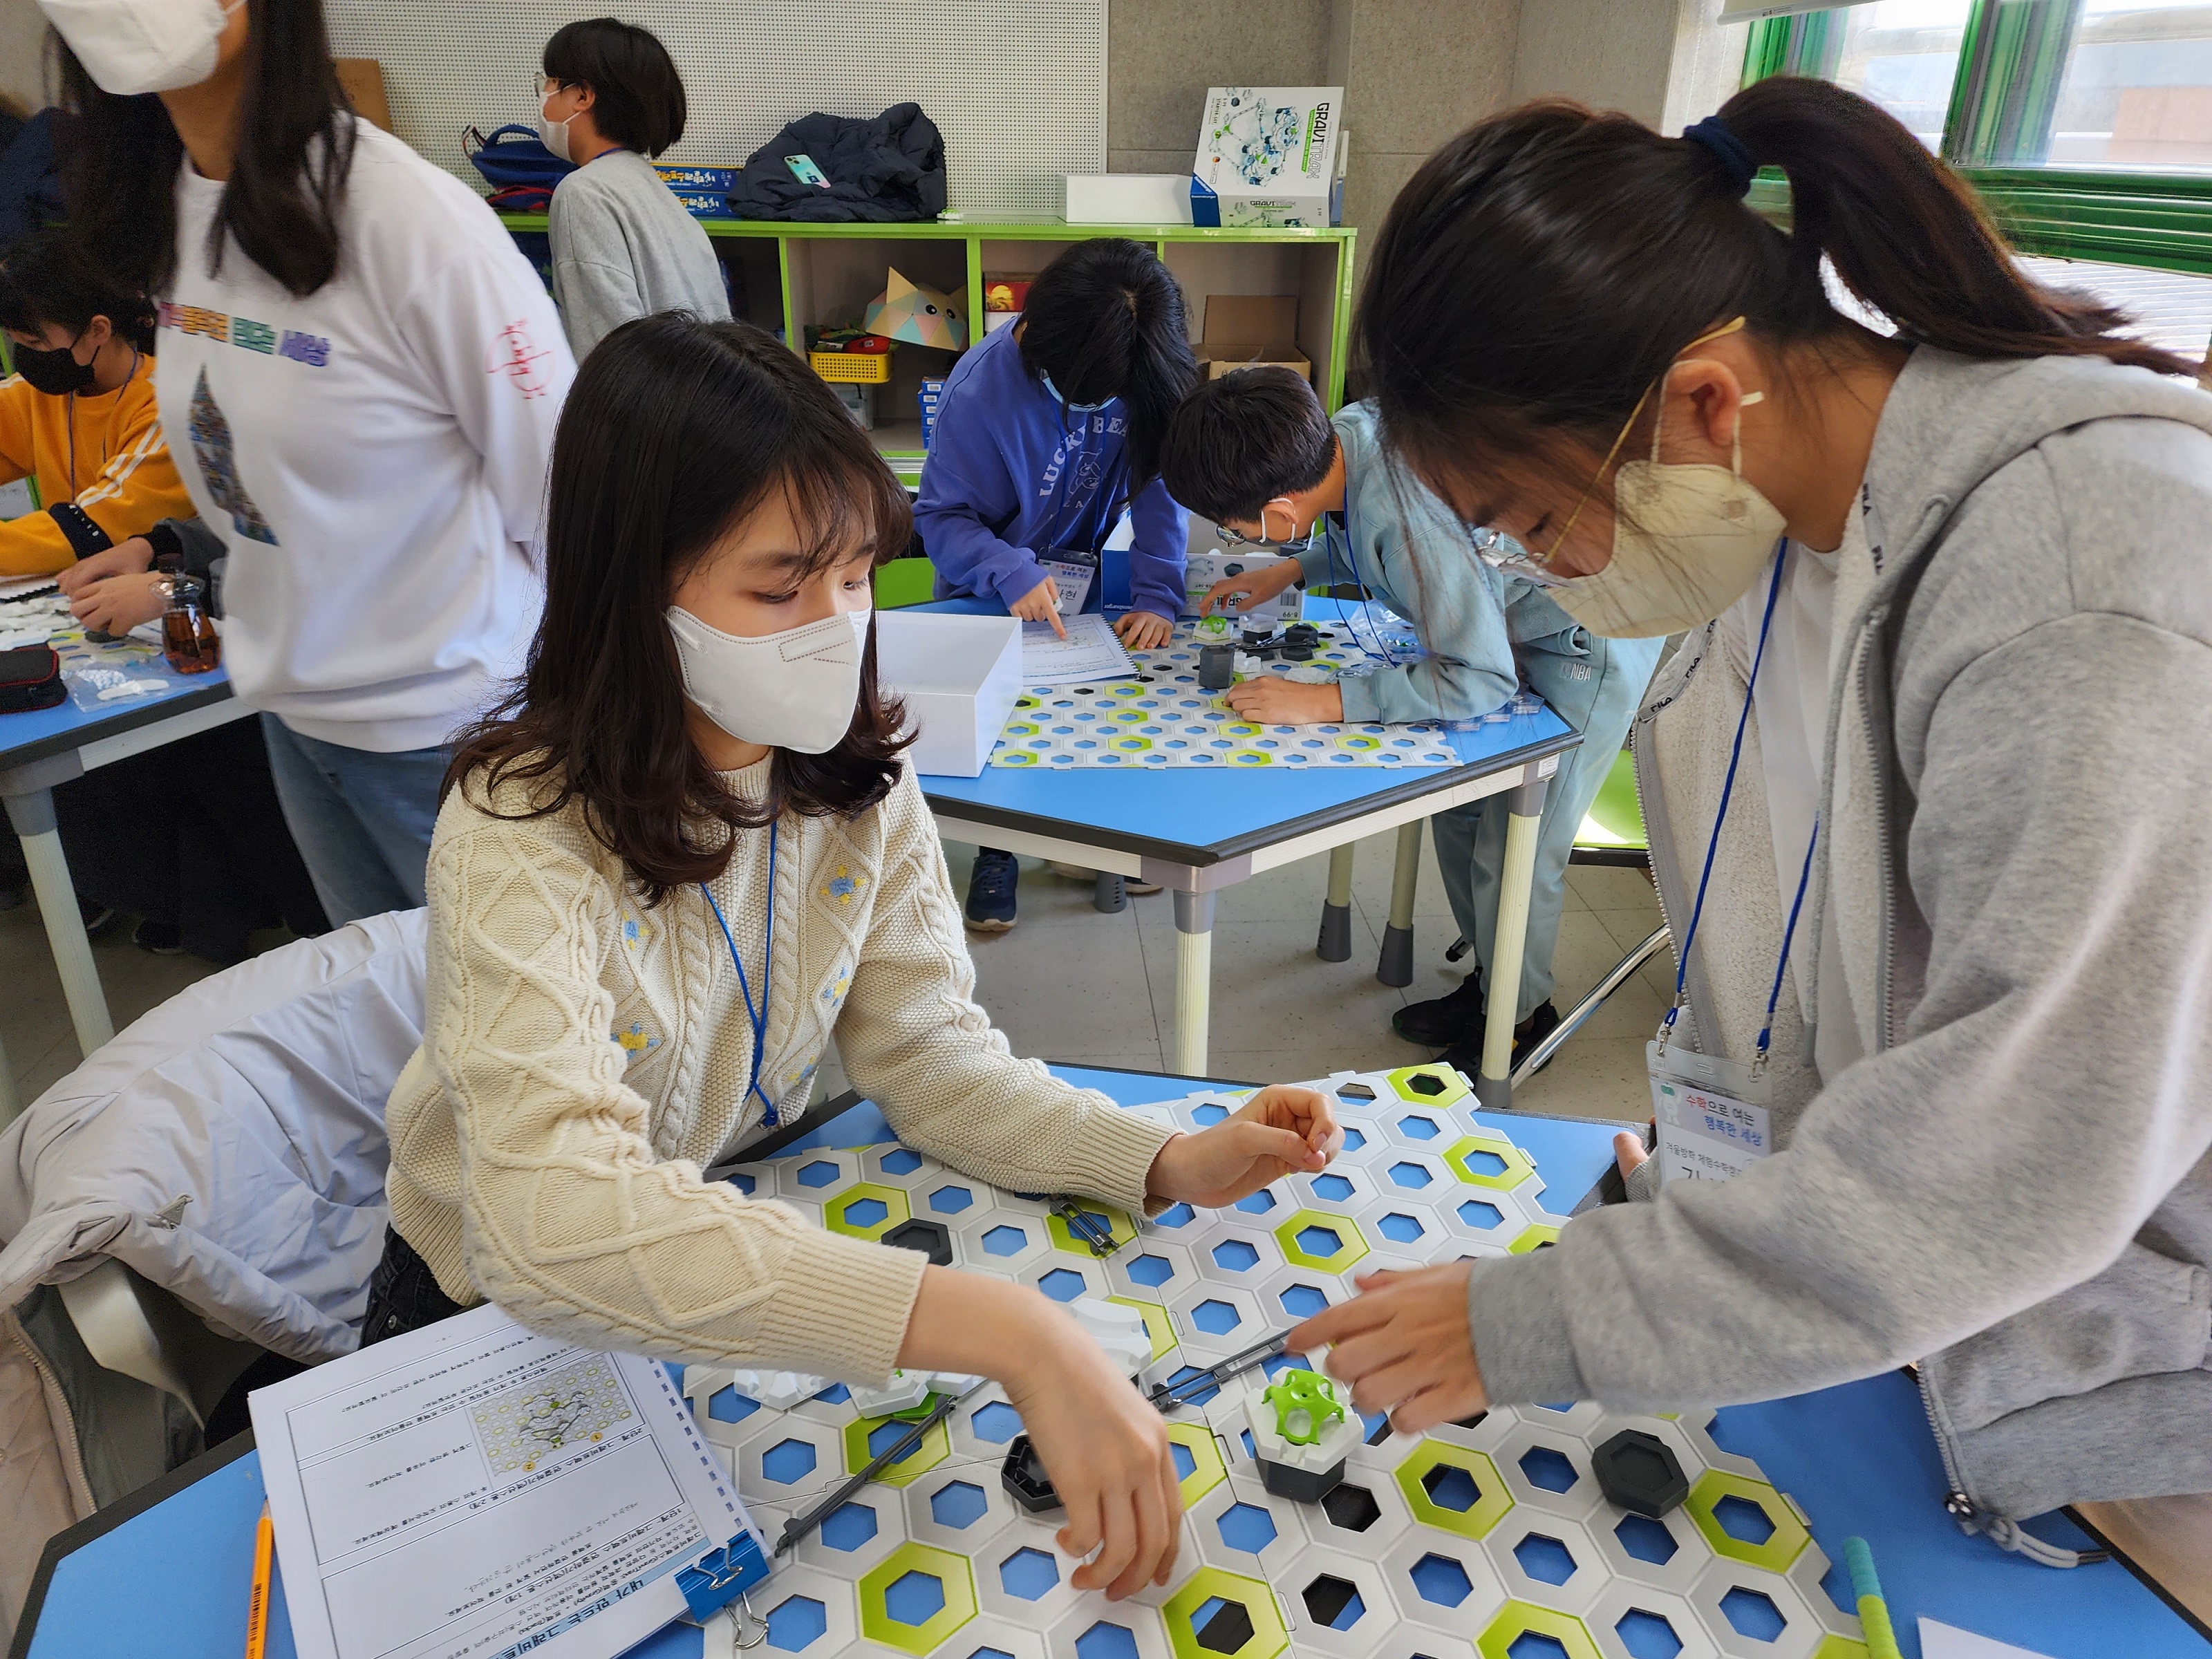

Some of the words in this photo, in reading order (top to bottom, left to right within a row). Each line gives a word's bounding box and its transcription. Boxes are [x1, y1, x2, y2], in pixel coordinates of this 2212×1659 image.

[1306, 102, 1330, 179] GRAVITRAX
[1093, 415, 1130, 437] BEA
[1570, 663, 1592, 682] NBA
[1686, 1094, 1730, 1117] 수학으로
[1732, 1108, 1755, 1127] 여는
[1704, 1115, 1737, 1138] 행복한
[565, 1441, 615, 1466] 그래비트랙스
[602, 1523, 653, 1552] 그래비트랙스
[616, 1580, 644, 1600] 내가
[568, 1597, 610, 1625] 만드는
[496, 1624, 560, 1659] 그래비트
